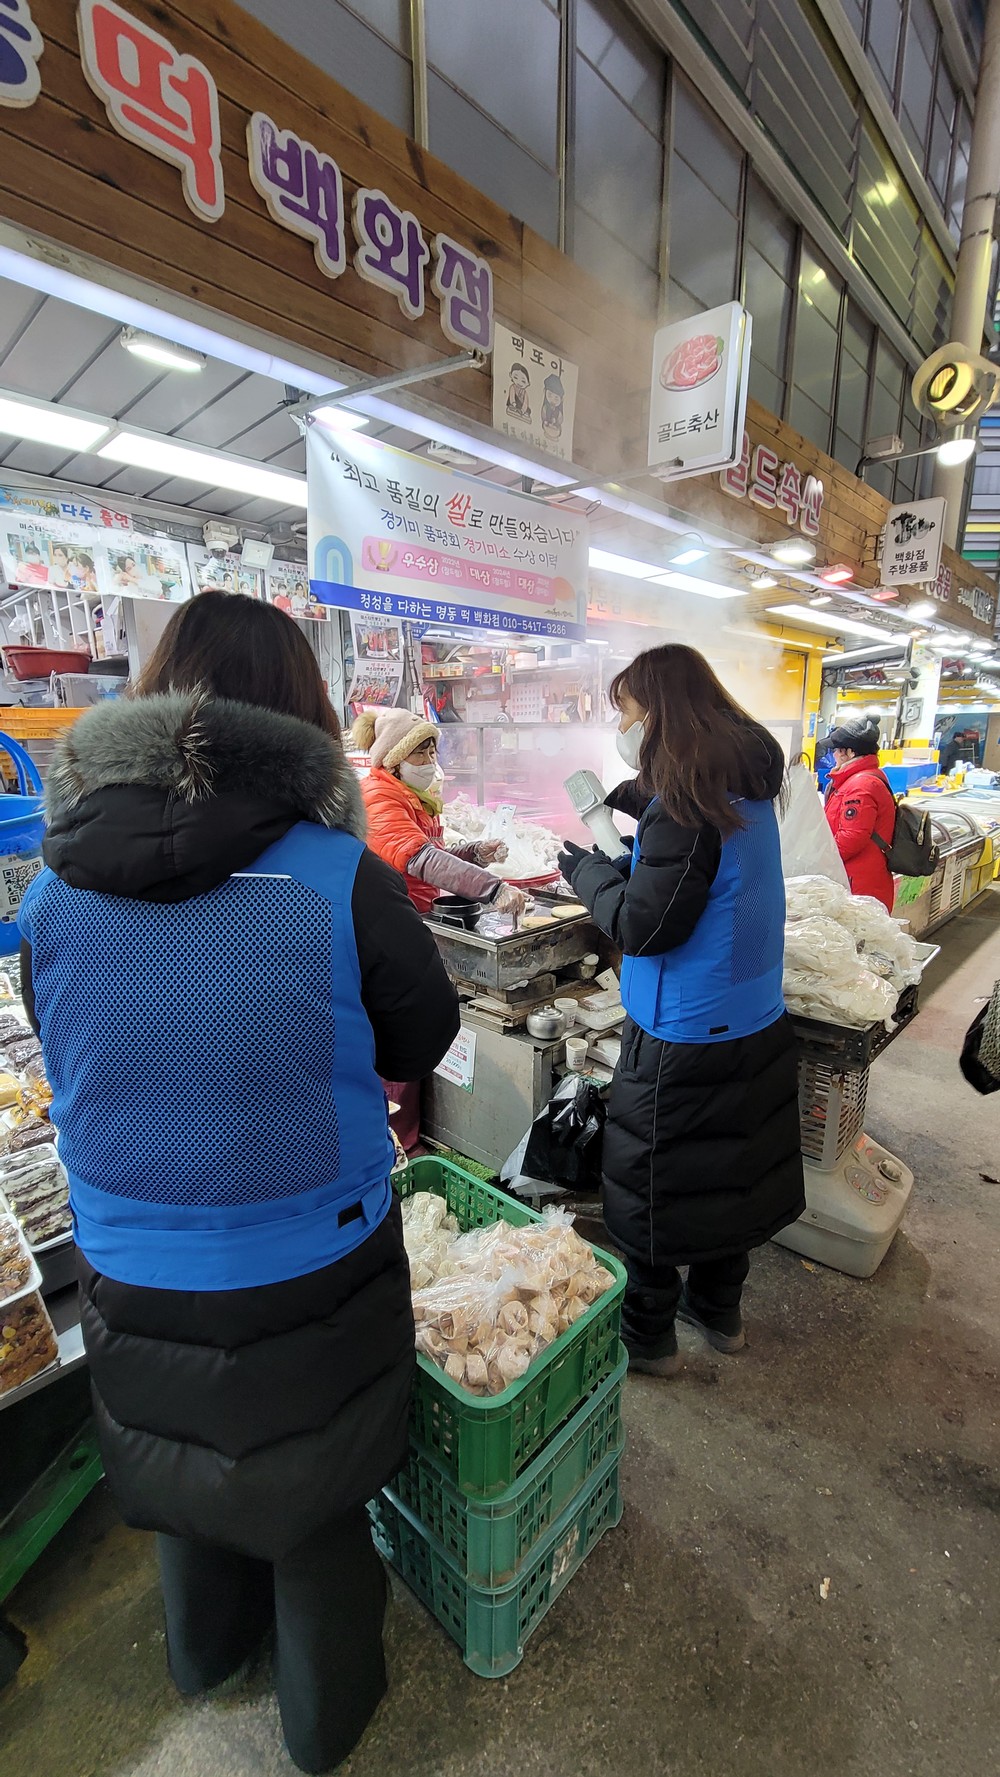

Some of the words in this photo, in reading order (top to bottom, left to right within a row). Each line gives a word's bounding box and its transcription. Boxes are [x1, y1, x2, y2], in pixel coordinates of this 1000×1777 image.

[81, 0, 222, 217] 떡
[250, 114, 492, 353] 백화점
[657, 408, 719, 443] 골드축산
[61, 503, 93, 520] 다수
[100, 509, 130, 529] 출연
[386, 479, 440, 518] 품질의
[445, 493, 484, 528] 쌀로
[381, 509, 421, 537] 경기미
[424, 524, 461, 549] 품평회
[463, 536, 511, 560] 경기미소
[513, 548, 536, 565] 수상
[538, 552, 558, 570] 이력
[895, 549, 926, 562] 백화점
[402, 552, 439, 576] 우수상
[469, 567, 491, 586] 대상
[518, 577, 535, 595] 대상
[888, 561, 929, 576] 주방용품
[360, 593, 393, 612] 정성을
[397, 600, 432, 617] 다하는
[436, 606, 457, 622] 명동
[461, 610, 470, 624] 떡
[474, 610, 500, 628] 백화점
[502, 616, 567, 635] 010-5417-9286
